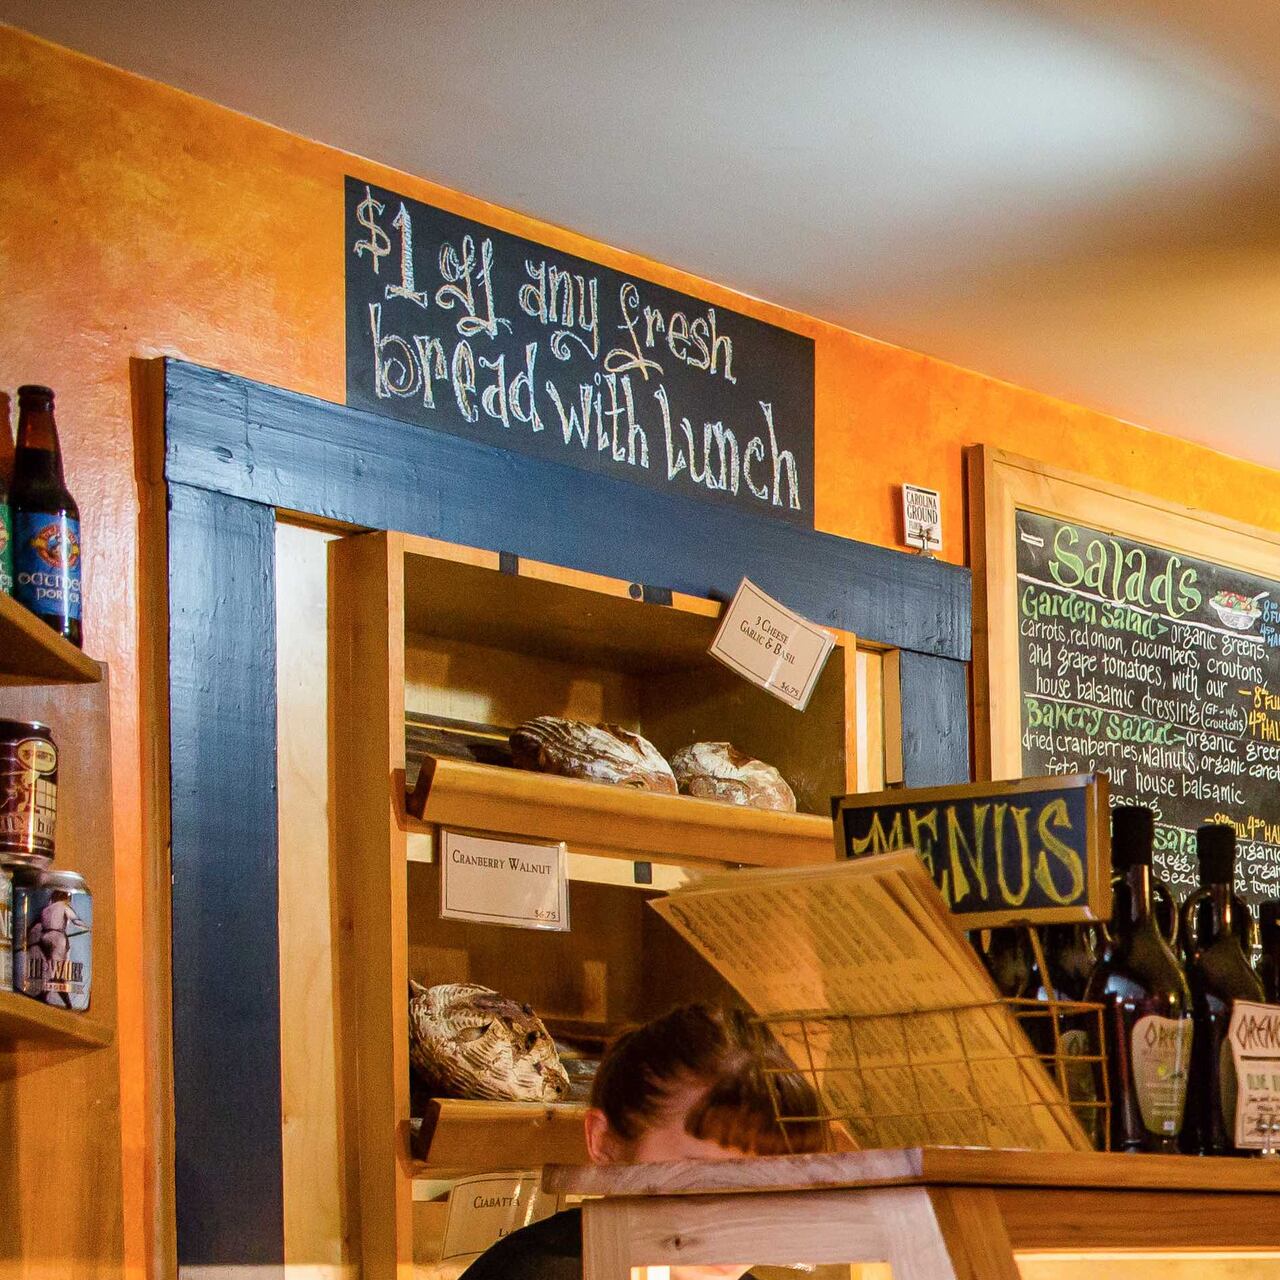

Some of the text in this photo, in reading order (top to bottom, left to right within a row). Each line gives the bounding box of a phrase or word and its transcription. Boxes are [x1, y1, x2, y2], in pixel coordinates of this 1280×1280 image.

[353, 185, 738, 384] $1 off any fresh
[369, 302, 543, 433] bread
[546, 372, 650, 469] with
[906, 491, 937, 510] CAROLINA
[906, 503, 938, 525] GROUND
[1049, 525, 1202, 618] Salads
[1029, 642, 1228, 701] and grape tomatoes, with our
[1036, 669, 1199, 726] house balsamic dressing
[1022, 728, 1053, 752] dried
[1056, 734, 1141, 763] cranberries,
[1201, 756, 1247, 777] organic
[1136, 768, 1246, 806] house balsamic
